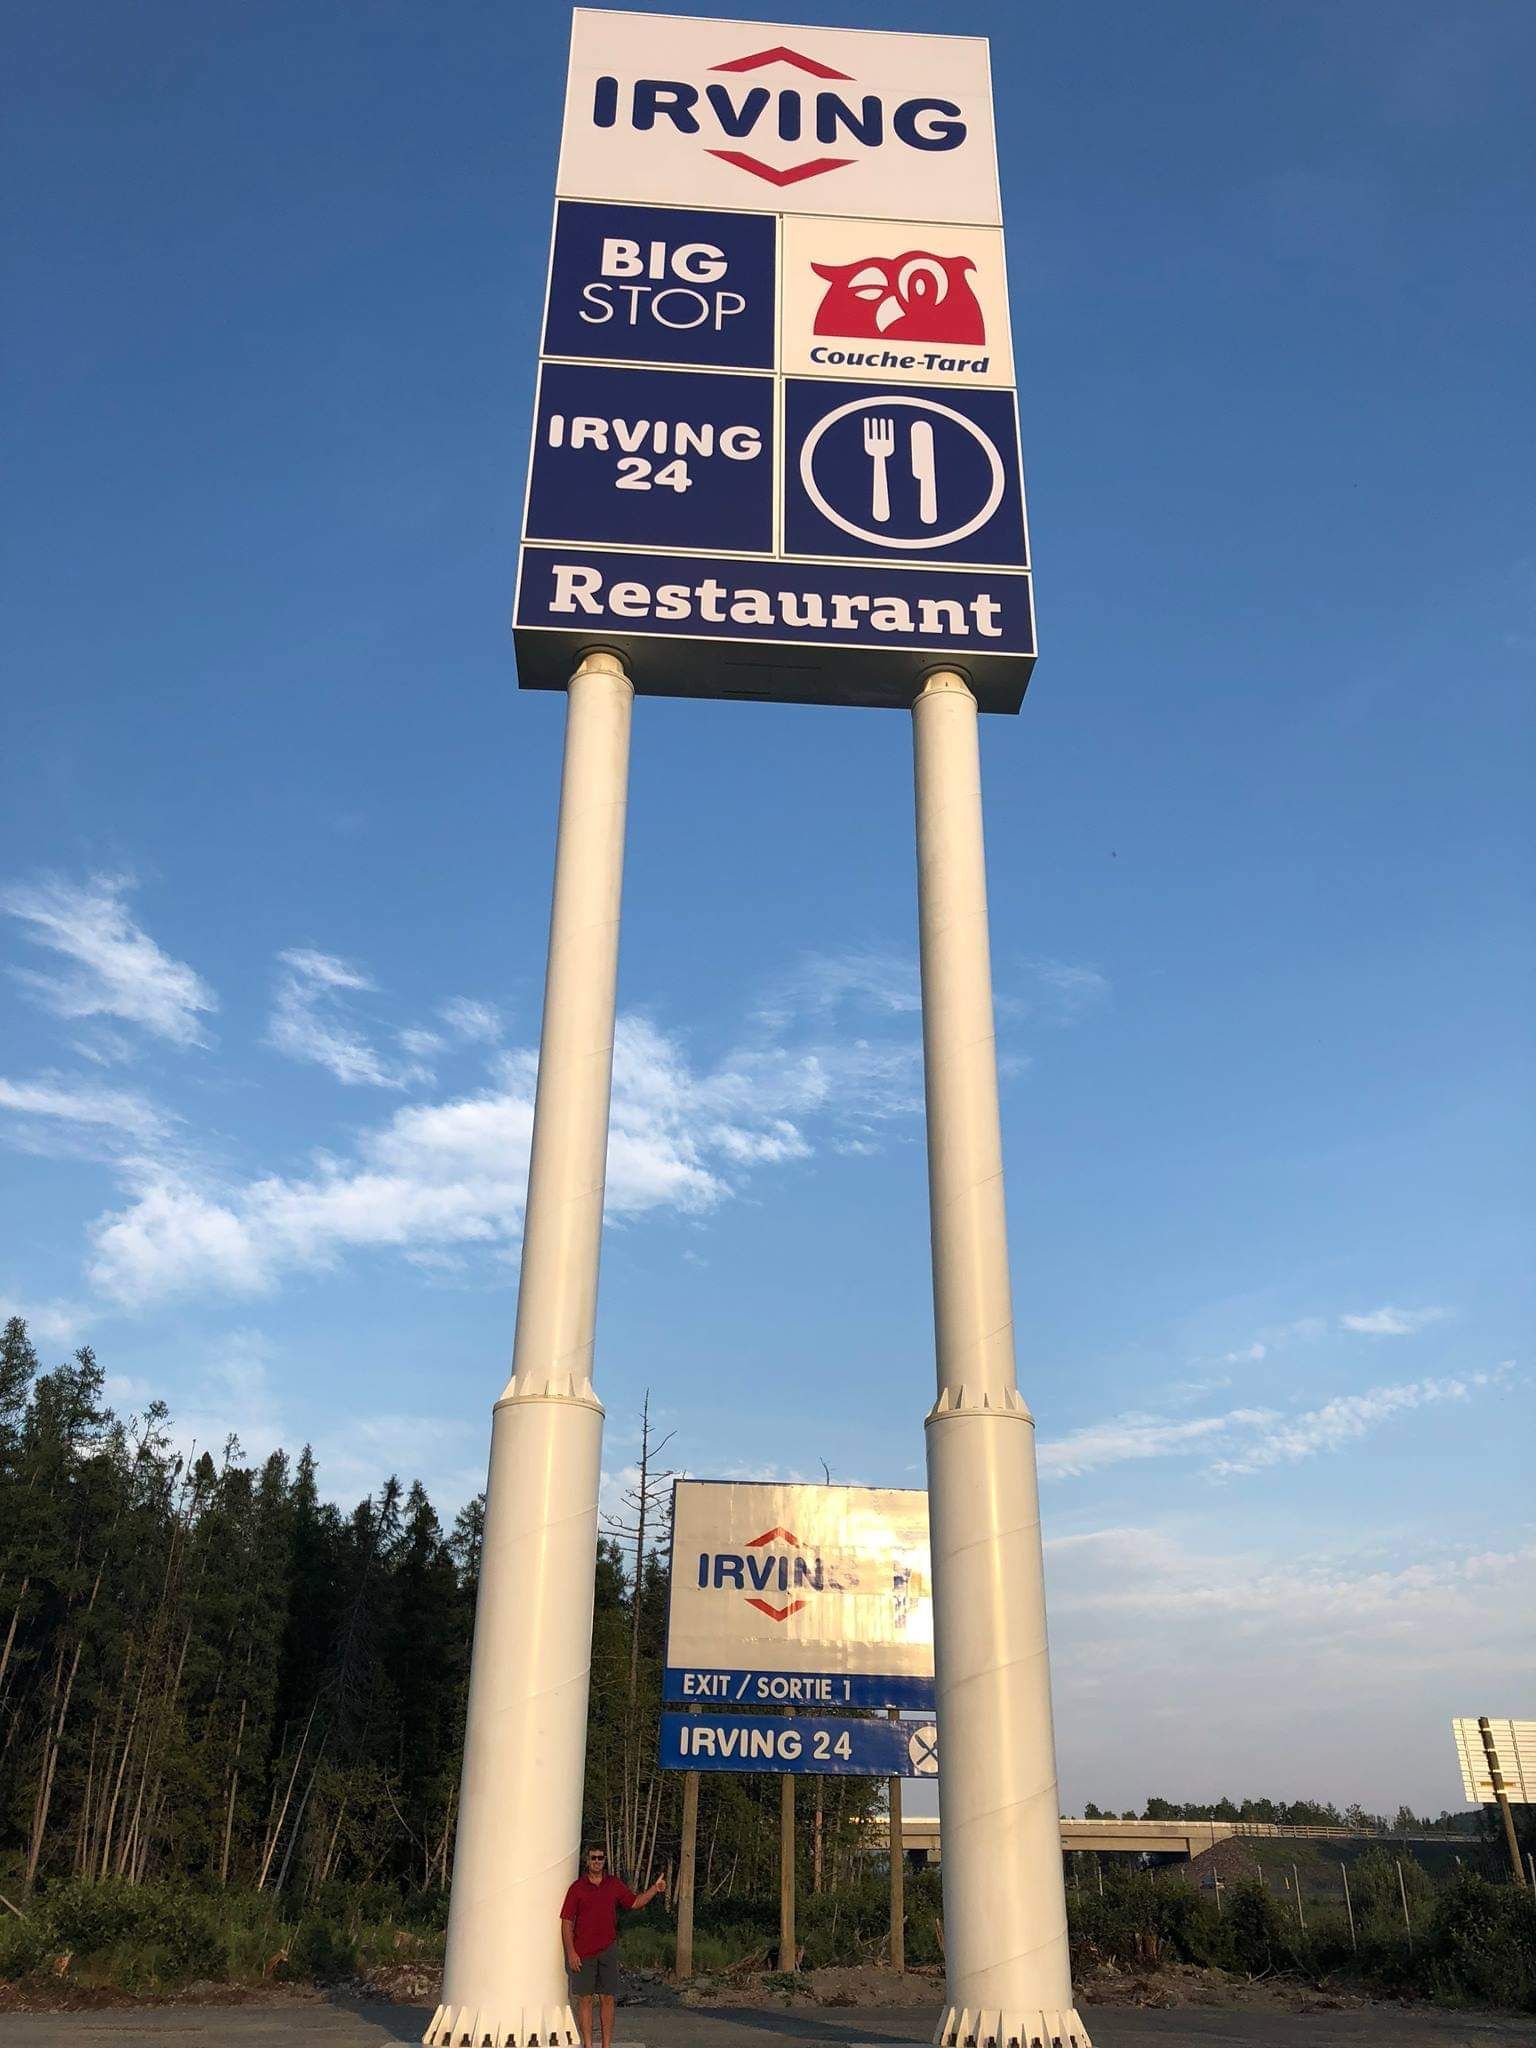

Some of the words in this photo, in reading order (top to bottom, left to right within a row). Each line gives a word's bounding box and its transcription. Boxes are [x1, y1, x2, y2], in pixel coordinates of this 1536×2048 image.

[593, 76, 967, 152] IRVING
[600, 237, 728, 284] BIG
[578, 282, 746, 331] STOP
[809, 346, 989, 374] Couche-Tard
[548, 414, 762, 461] IRVING
[615, 456, 692, 494] 24
[548, 564, 1003, 637] Restaurant
[682, 1673, 731, 1697] EXIT
[756, 1677, 832, 1701] SORTIE
[842, 1679, 851, 1701] 1
[680, 1726, 802, 1761] IRVING
[812, 1731, 852, 1761] 24
